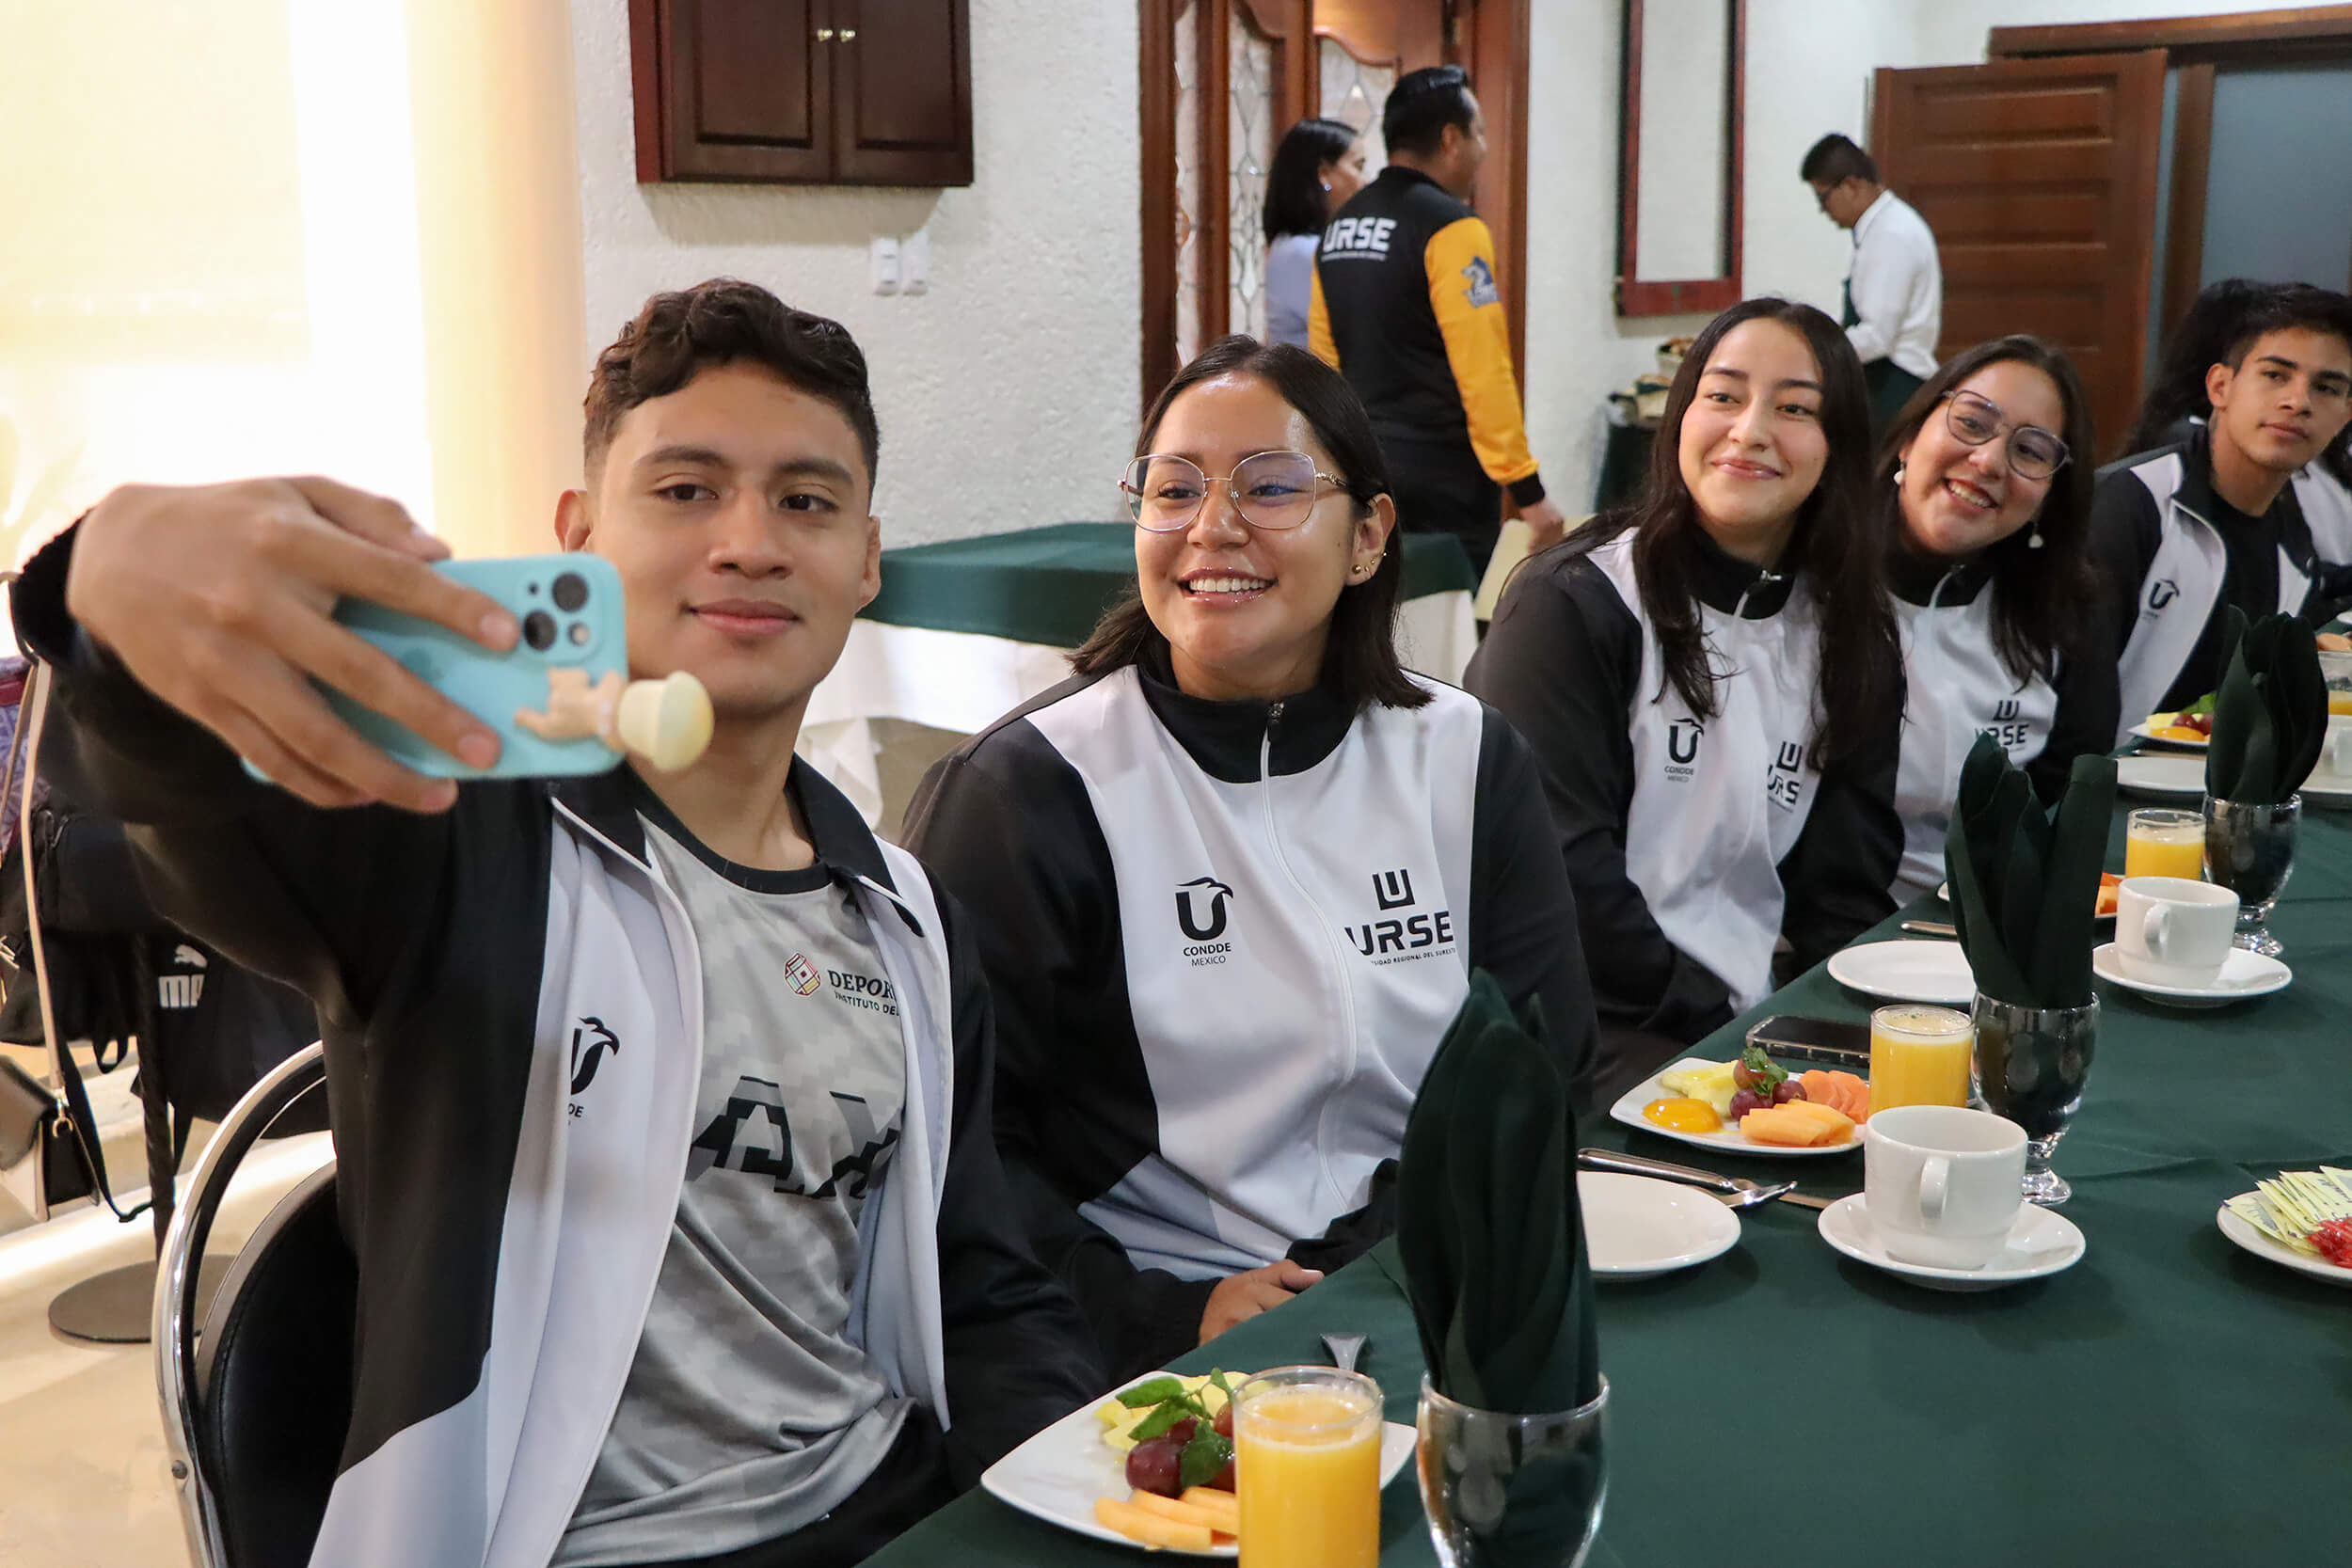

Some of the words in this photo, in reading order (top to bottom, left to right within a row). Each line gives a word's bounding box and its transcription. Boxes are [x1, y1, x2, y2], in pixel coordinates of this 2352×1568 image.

[1322, 216, 1397, 253] URSE
[1343, 911, 1454, 957] URSE
[1183, 942, 1232, 957] CONDDE
[1191, 955, 1227, 967] MEXICO
[1393, 954, 1422, 963] REGIONAL
